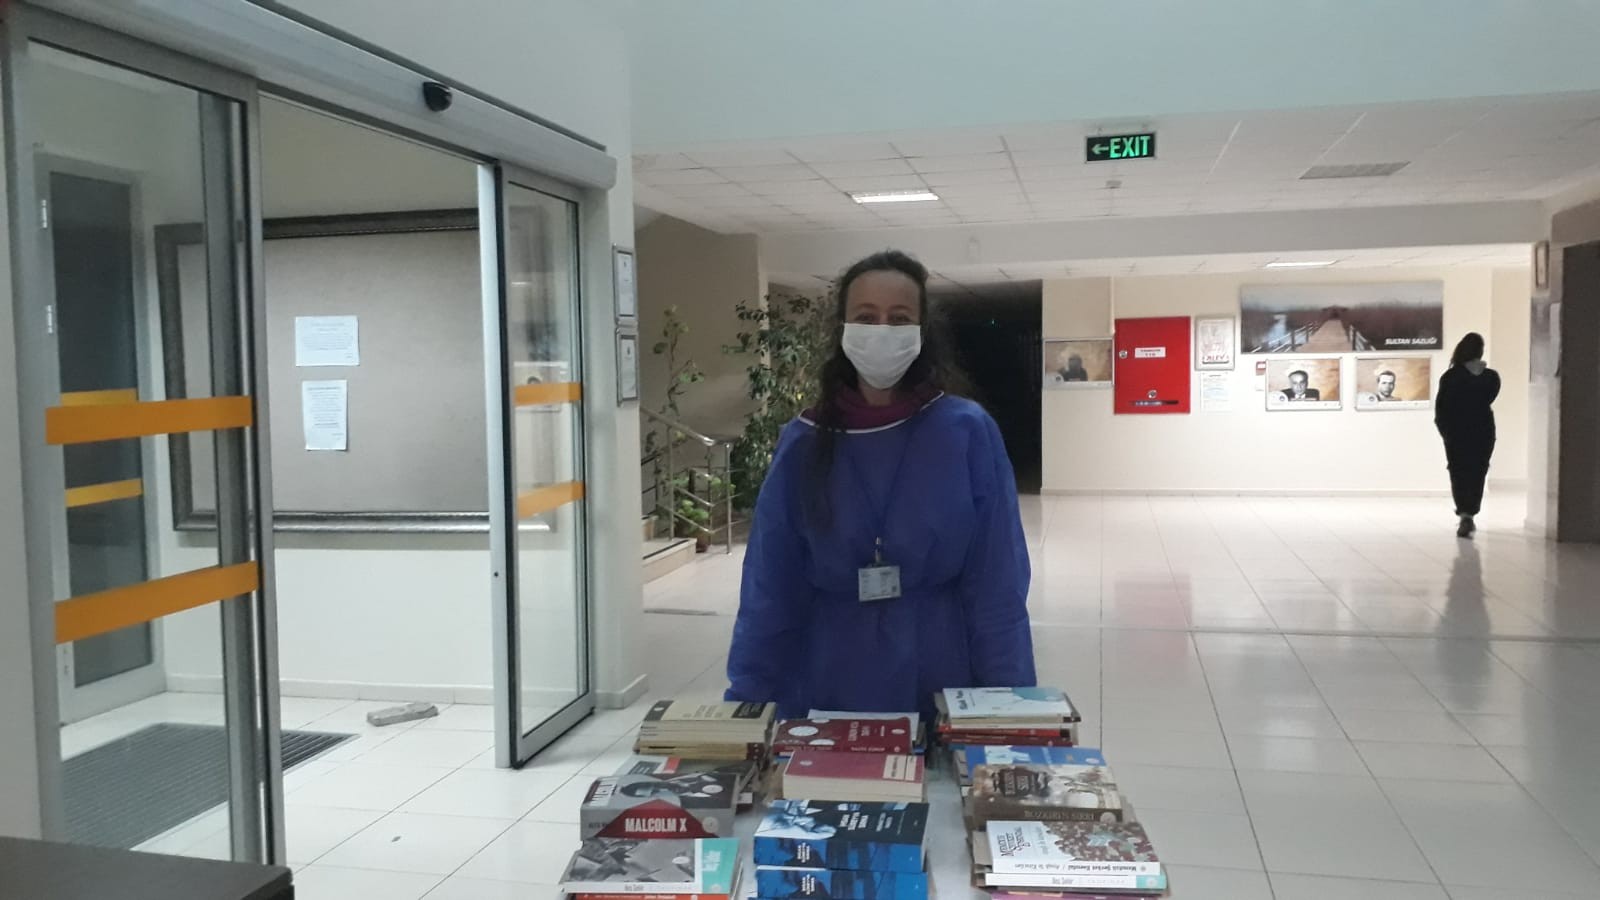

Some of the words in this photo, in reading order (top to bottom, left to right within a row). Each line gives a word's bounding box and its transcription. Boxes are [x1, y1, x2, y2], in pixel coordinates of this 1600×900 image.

[1110, 135, 1151, 158] EXIT
[1385, 337, 1411, 345] SULTAN
[625, 818, 677, 832] MALCOLM
[680, 818, 687, 832] X
